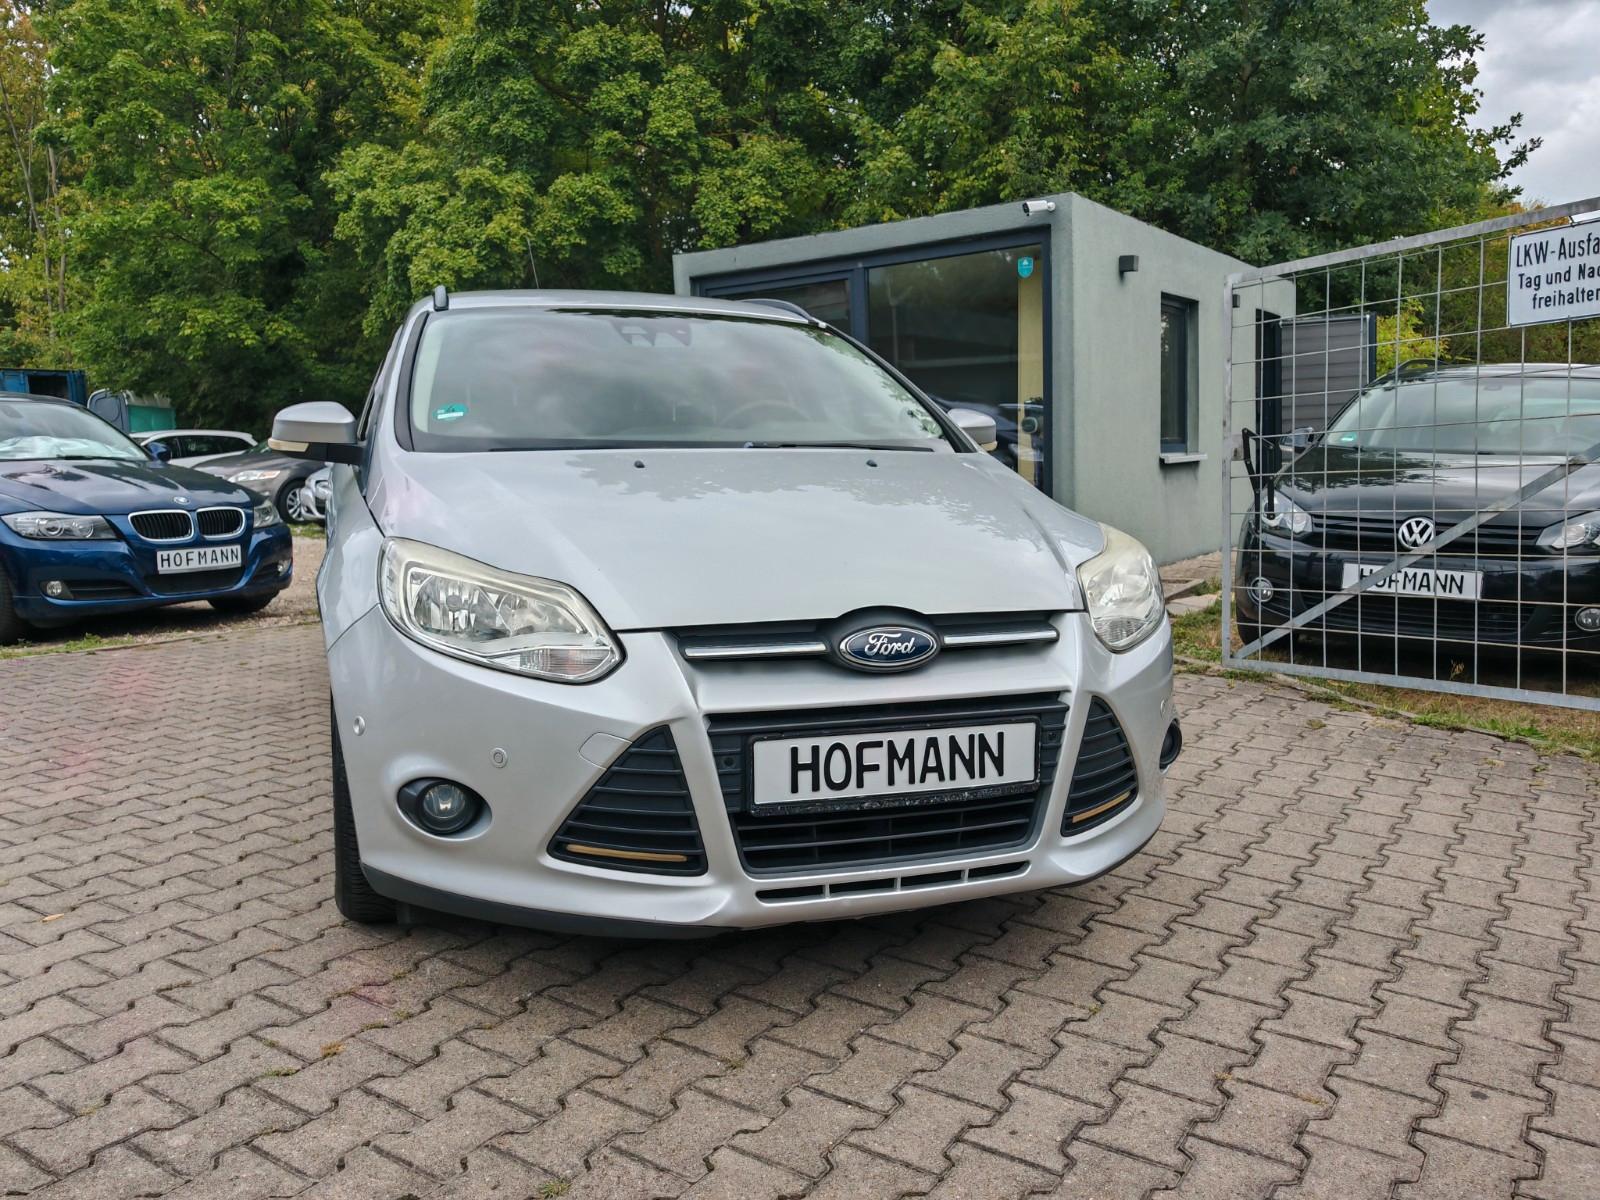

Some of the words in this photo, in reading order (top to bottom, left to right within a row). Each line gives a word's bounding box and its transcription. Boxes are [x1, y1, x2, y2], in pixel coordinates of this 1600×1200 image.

[1518, 273, 1541, 291] Tag
[1546, 266, 1571, 285] und
[160, 547, 239, 568] HOFMANN
[864, 632, 915, 656] Ford
[790, 731, 1005, 794] HOFMANN
